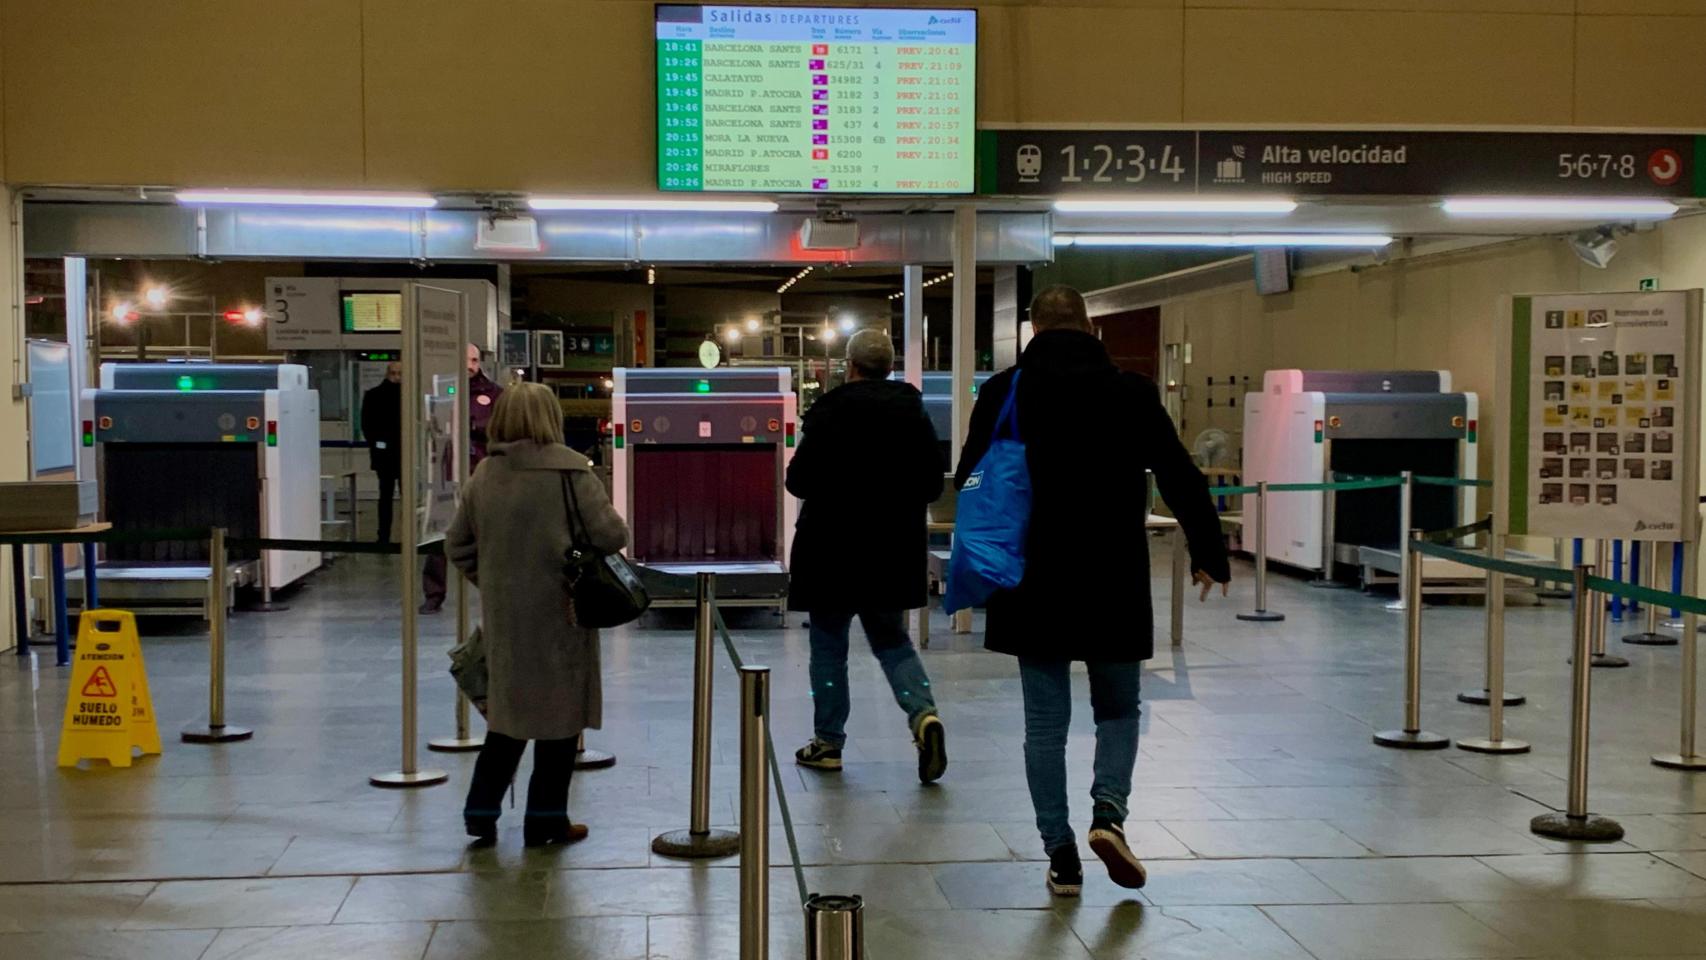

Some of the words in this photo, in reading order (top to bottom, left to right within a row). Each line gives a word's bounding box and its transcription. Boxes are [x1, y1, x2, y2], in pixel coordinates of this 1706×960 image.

[710, 10, 772, 24] Salidas
[781, 14, 860, 24] DEPARTURES
[665, 43, 697, 51] 18:41
[705, 44, 763, 52] BARCELONA
[769, 45, 802, 53] SANTS
[665, 58, 698, 66] 19:26
[768, 60, 800, 68] SANTS
[751, 90, 802, 98] P.ATOCHA
[770, 105, 802, 113] SANTS
[666, 118, 698, 126] 19:52
[705, 120, 763, 128] BARCELONA
[770, 120, 802, 128] SANTS
[757, 135, 789, 143] NUEVA
[666, 148, 698, 156] 20:17
[1262, 145, 1301, 164] Alta
[1308, 144, 1407, 164] velocidad
[705, 164, 770, 172] MIRAFLORES
[666, 178, 698, 186] 20:26
[705, 179, 744, 187] MADRID
[1262, 172, 1292, 184] HIGH
[1295, 172, 1332, 184] SPEED
[275, 299, 290, 324] 3
[1652, 308, 1664, 316] de
[569, 337, 577, 351] 3
[80, 702, 118, 713] SUELO
[72, 714, 122, 726] HUMEDO
